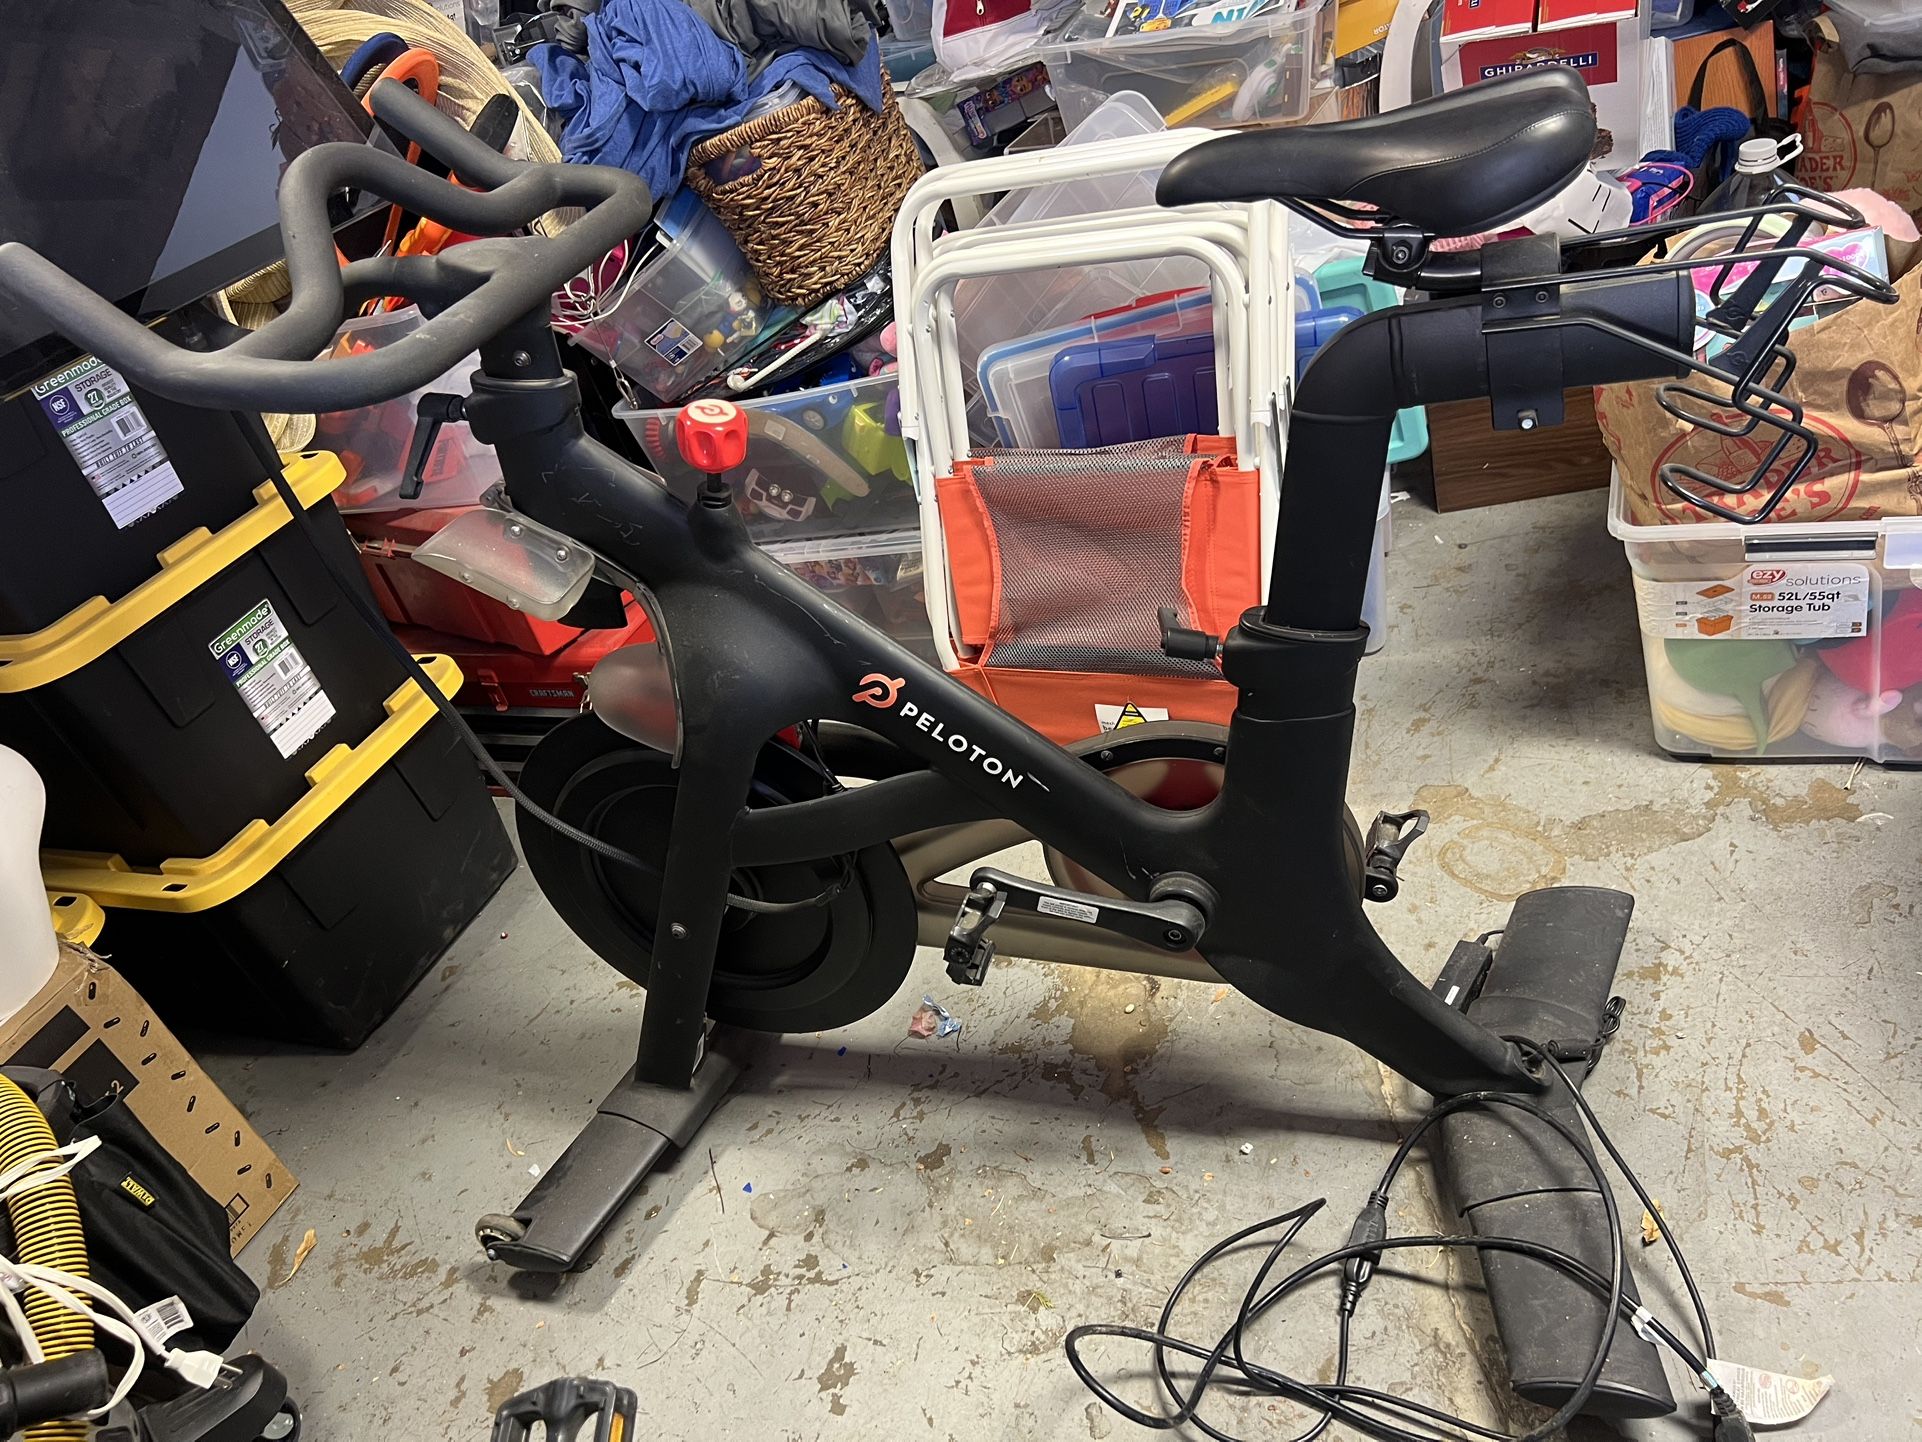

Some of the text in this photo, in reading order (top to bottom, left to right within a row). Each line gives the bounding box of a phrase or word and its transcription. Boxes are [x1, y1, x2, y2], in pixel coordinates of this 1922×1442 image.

[73, 367, 112, 393] STORAGE
[51, 398, 66, 412] NSF
[87, 390, 99, 404] 27
[61, 411, 102, 437] PROFESSIONAL
[101, 401, 119, 415] GRADE
[119, 395, 131, 405] BOX
[1751, 569, 1861, 587] ezy solutions
[1777, 590, 1842, 602] 52L/55qt
[1749, 602, 1831, 615] Storage Tub
[212, 606, 269, 653] Greenmade
[244, 618, 274, 645] STORAGE
[255, 642, 265, 654] 27
[900, 701, 1024, 789] PELOTON
